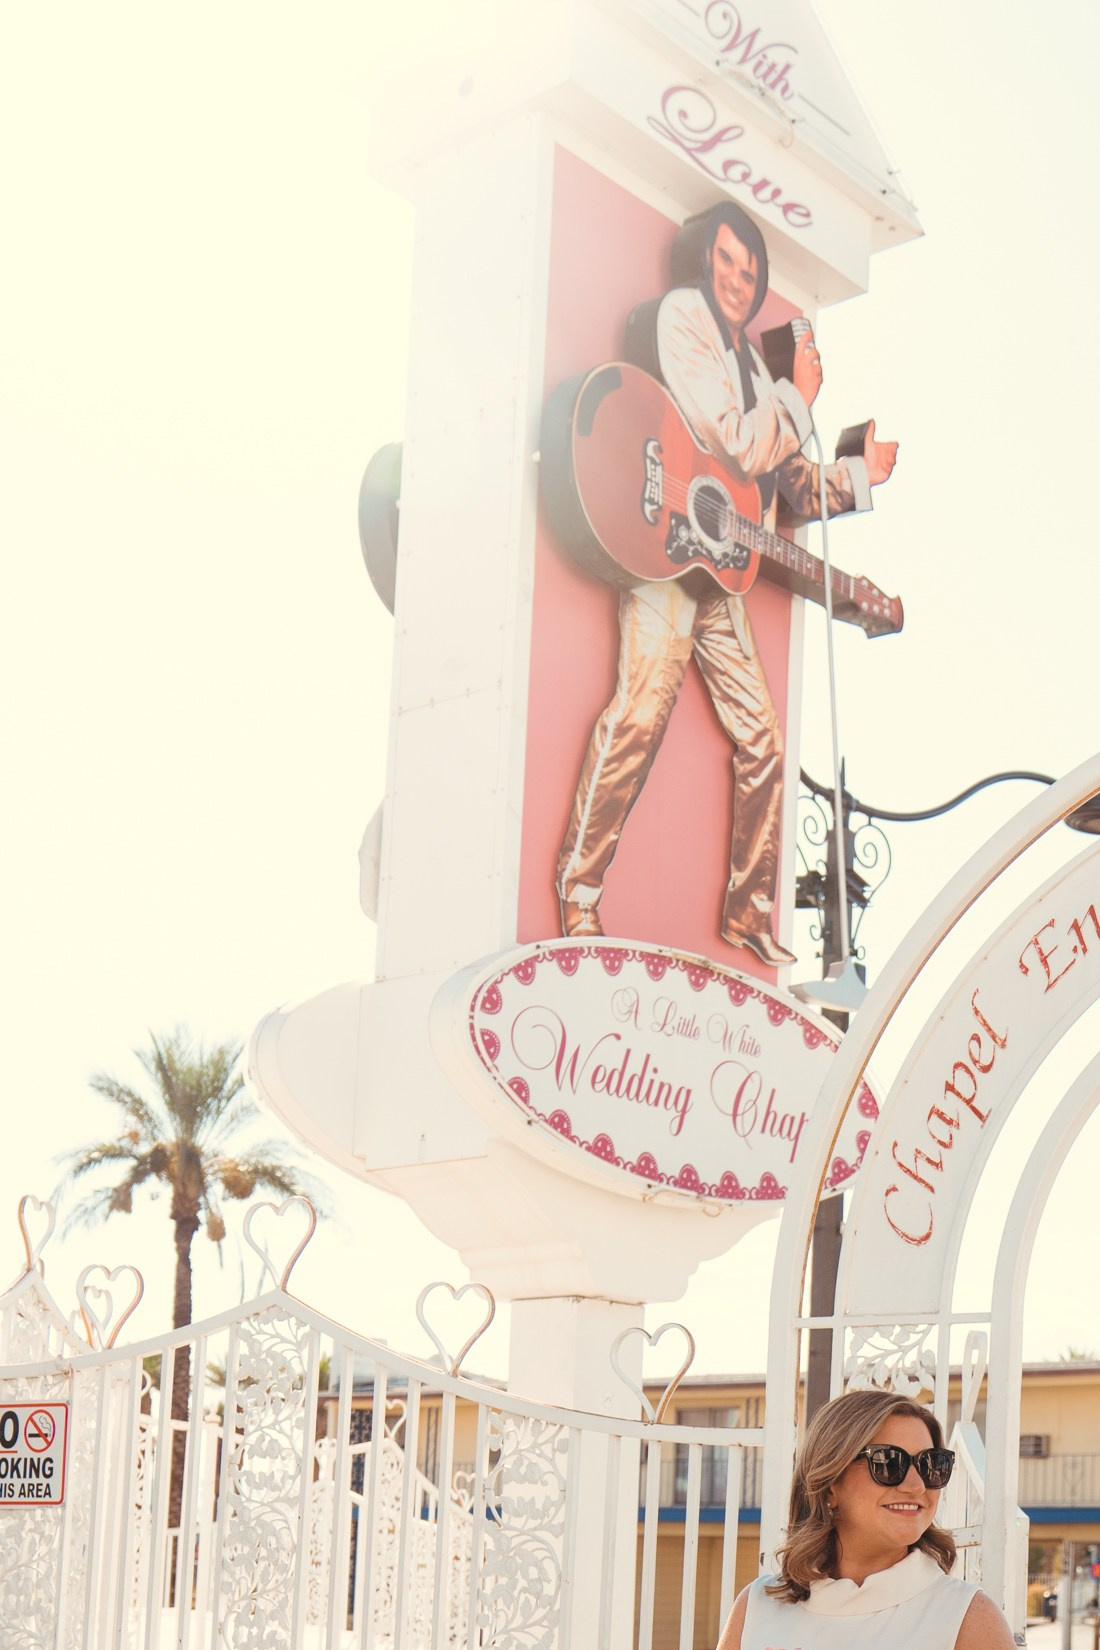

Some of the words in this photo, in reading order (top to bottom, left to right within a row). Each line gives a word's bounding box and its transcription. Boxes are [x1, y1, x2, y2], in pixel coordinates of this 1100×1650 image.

[704, 0, 798, 101] With
[646, 85, 813, 228] Love
[611, 986, 642, 1031] A
[650, 996, 701, 1040] Little
[706, 1013, 761, 1057] White
[510, 1004, 694, 1137] Wedding
[709, 1060, 809, 1164] Chap
[883, 987, 1009, 1247] Chapel
[0, 1410, 19, 1449] O
[0, 1457, 54, 1479] OKING
[18, 1483, 52, 1498] AREA
